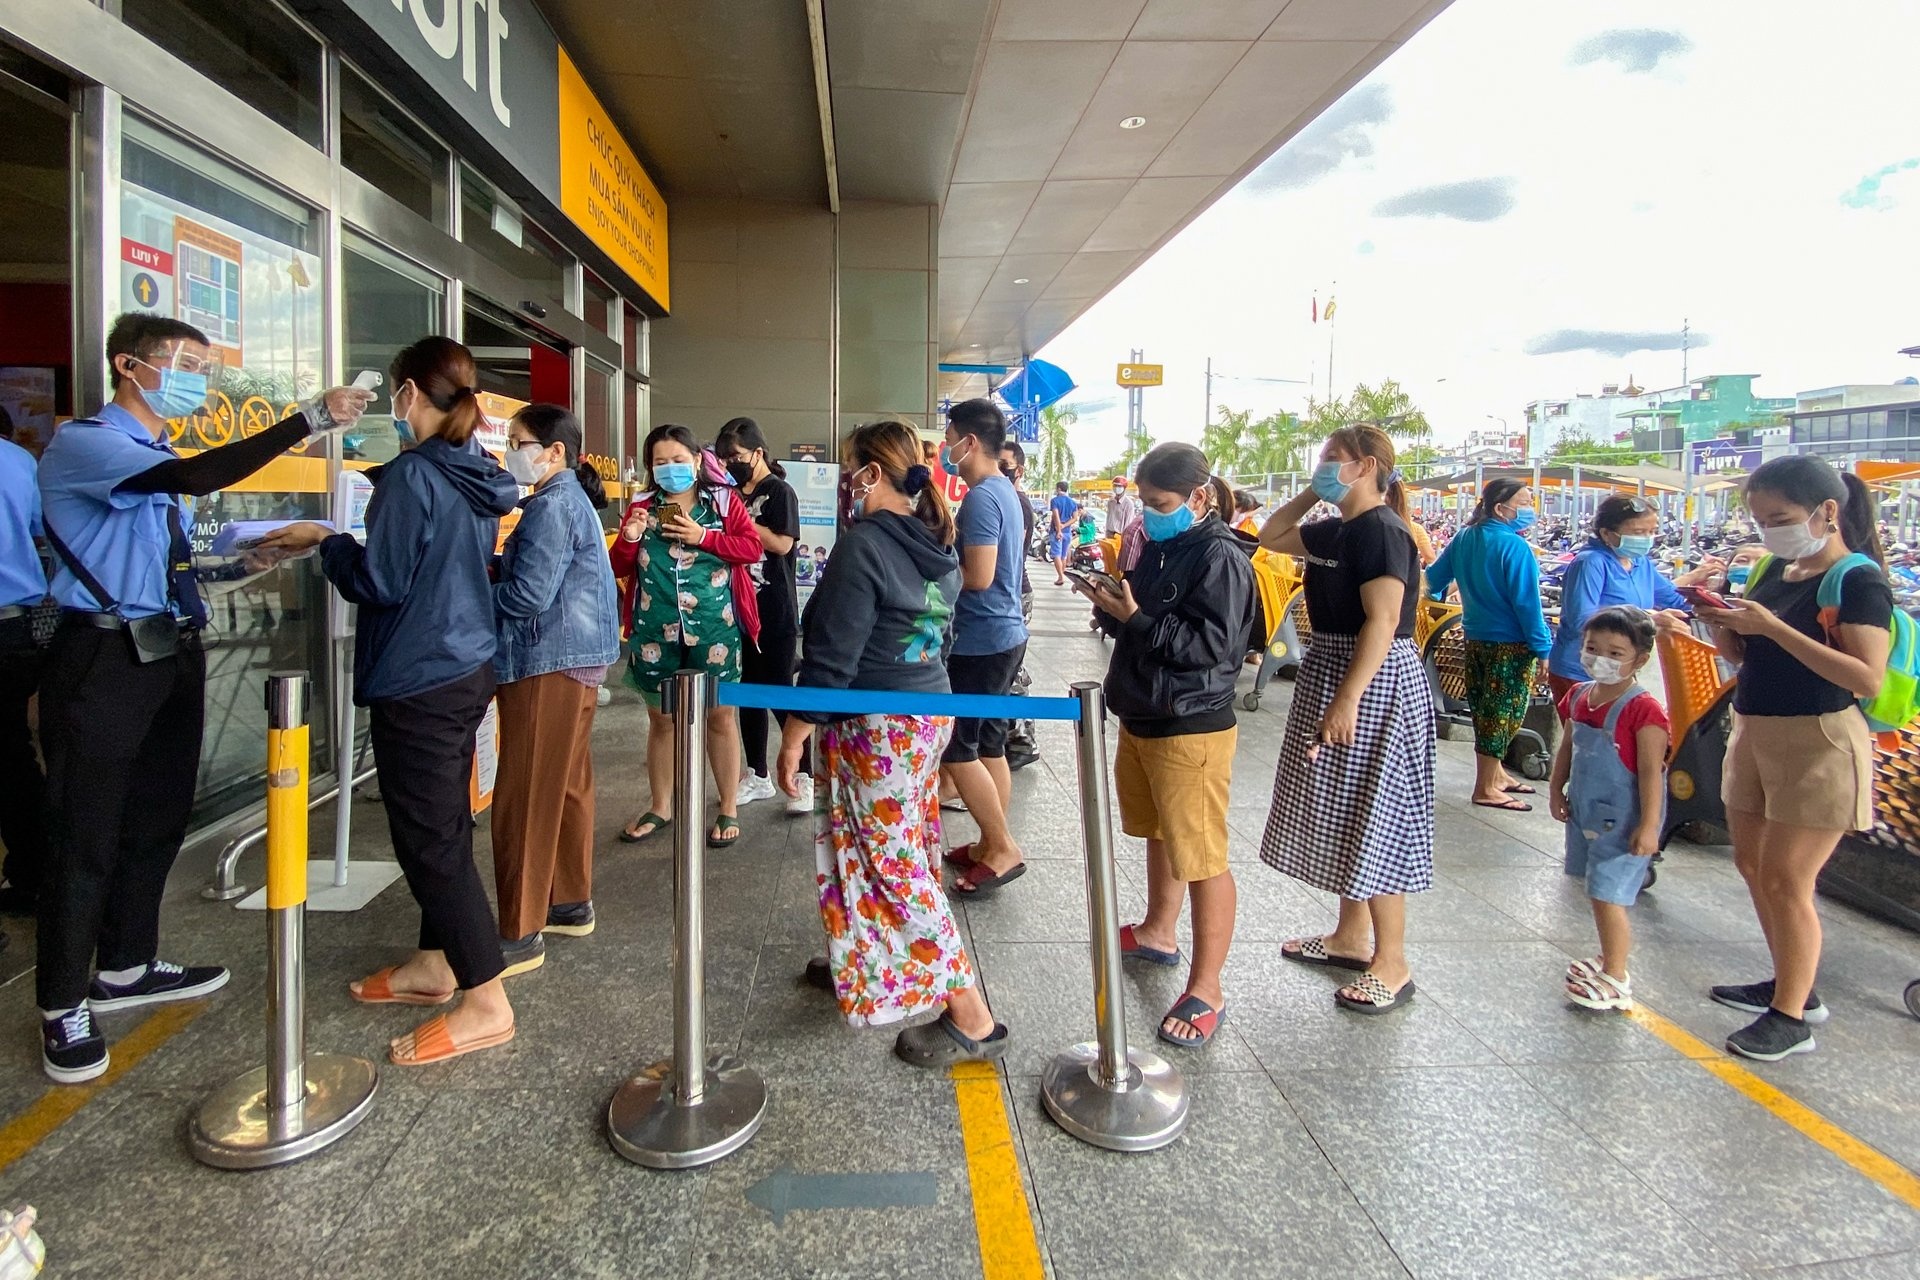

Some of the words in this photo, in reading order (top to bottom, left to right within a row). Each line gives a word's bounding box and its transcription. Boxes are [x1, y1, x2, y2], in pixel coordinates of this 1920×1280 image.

[390, 0, 510, 128] art
[587, 117, 613, 169] CHÚC
[613, 154, 632, 188] QUÝ
[631, 174, 656, 224] KHÁCH
[587, 196, 611, 233] ENJOY
[610, 221, 628, 252] YOUR
[589, 161, 611, 206] MUA
[611, 186, 629, 227] SẮM
[629, 217, 643, 240] VUI
[131, 246, 151, 264] LƯU
[152, 252, 160, 267] Ý
[1706, 454, 1743, 471] NUTY
[197, 519, 219, 536] MỞ
